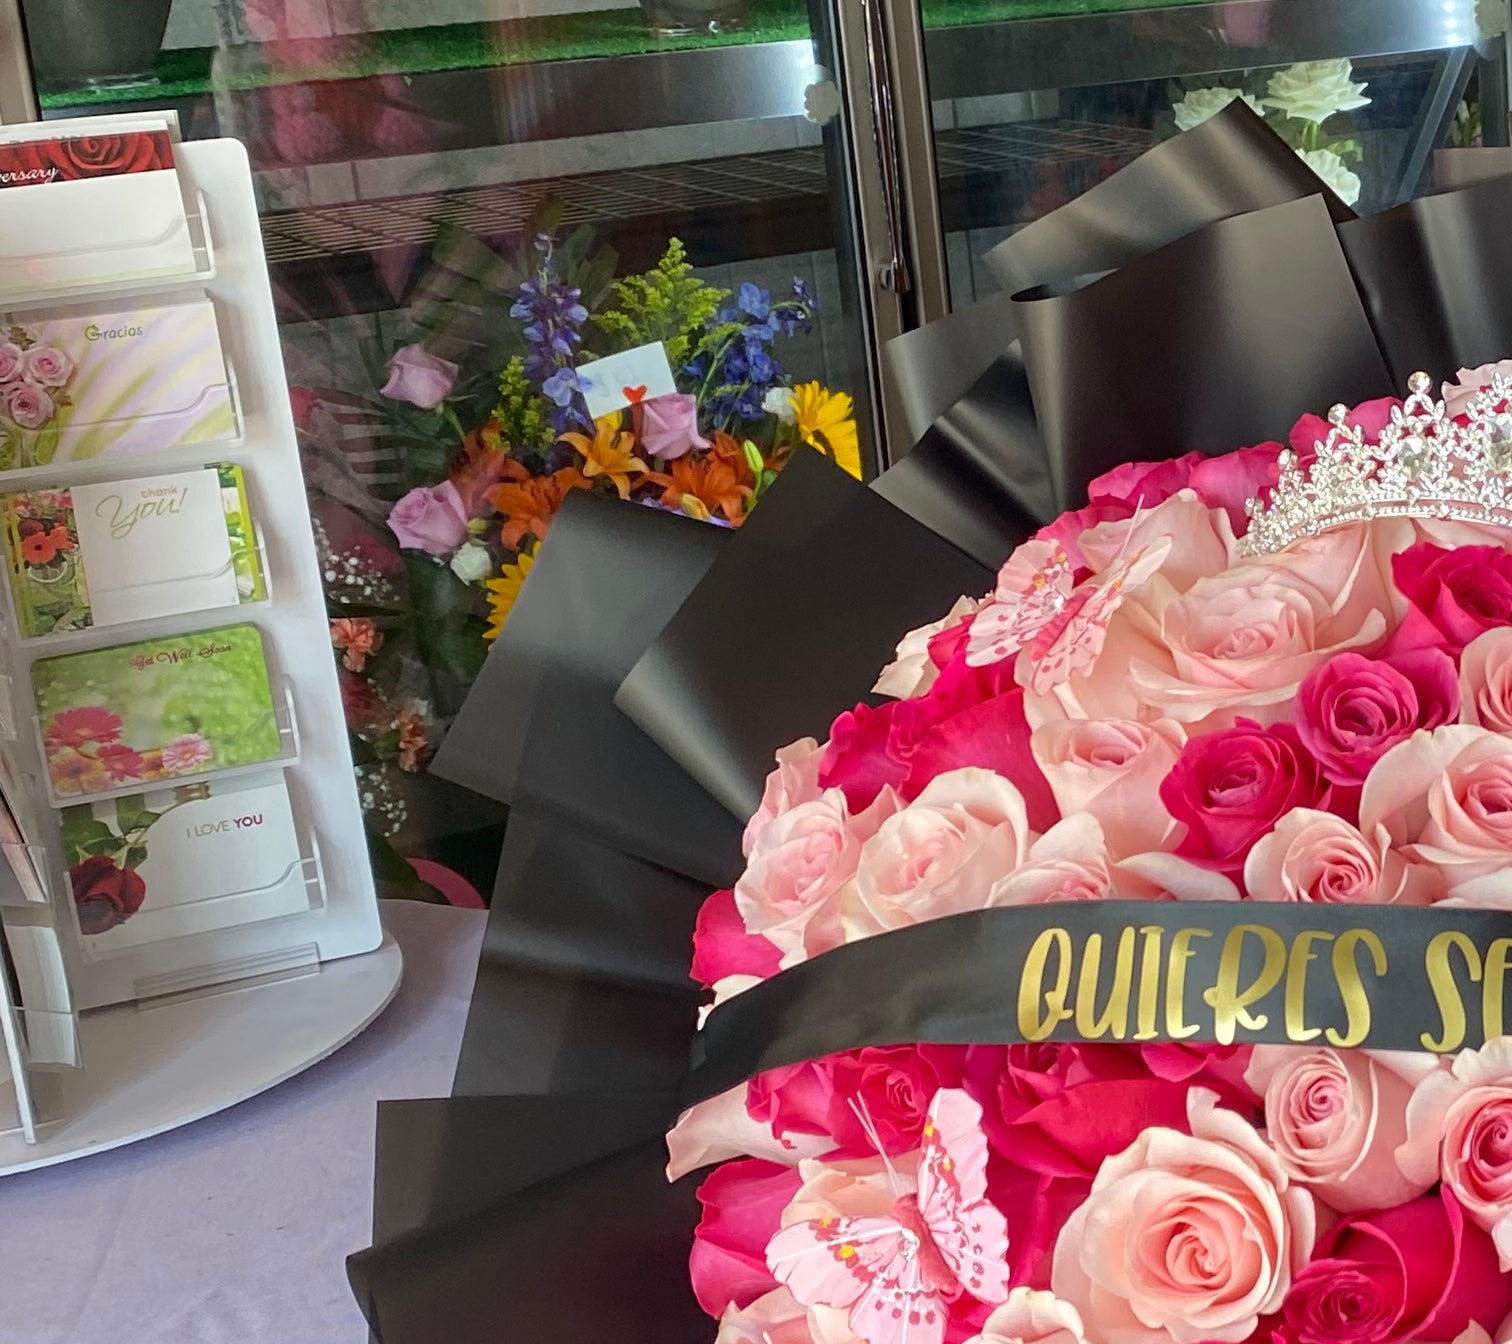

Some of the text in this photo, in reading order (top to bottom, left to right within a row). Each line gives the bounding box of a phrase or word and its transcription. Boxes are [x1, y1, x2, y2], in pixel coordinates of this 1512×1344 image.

[84, 324, 143, 342] Gracias
[140, 486, 178, 499] thank
[186, 814, 263, 839] I LOVE YOU
[1017, 923, 1388, 1047] QUIERES
